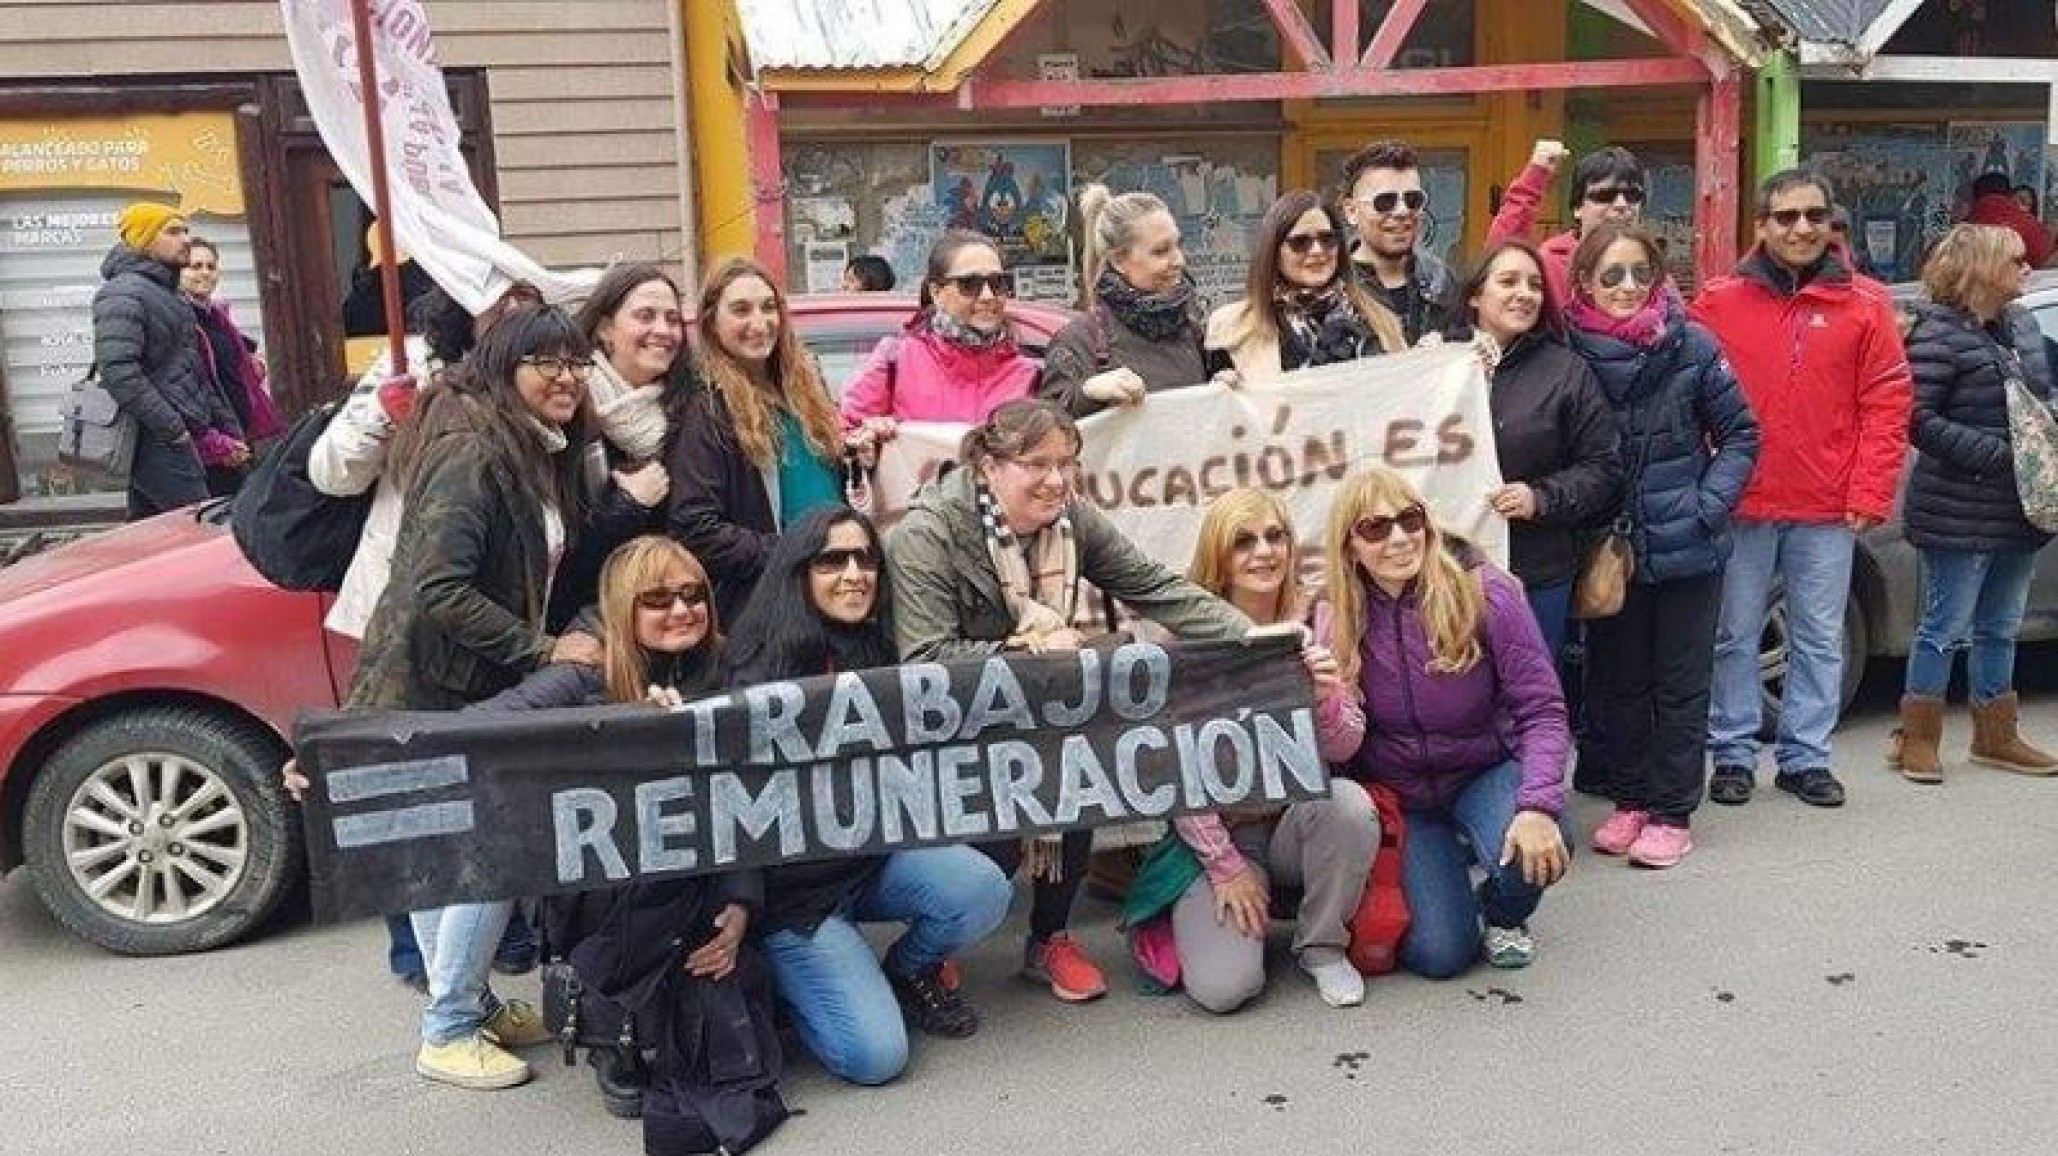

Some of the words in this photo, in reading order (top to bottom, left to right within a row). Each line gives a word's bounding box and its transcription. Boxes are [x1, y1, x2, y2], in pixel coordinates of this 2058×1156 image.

[85, 156, 141, 172] GATOS
[14, 230, 83, 246] MARCAS
[1384, 413, 1475, 470] ES
[667, 643, 1170, 767] TRABAJO
[552, 706, 1327, 884] REMUNERACIÓN
